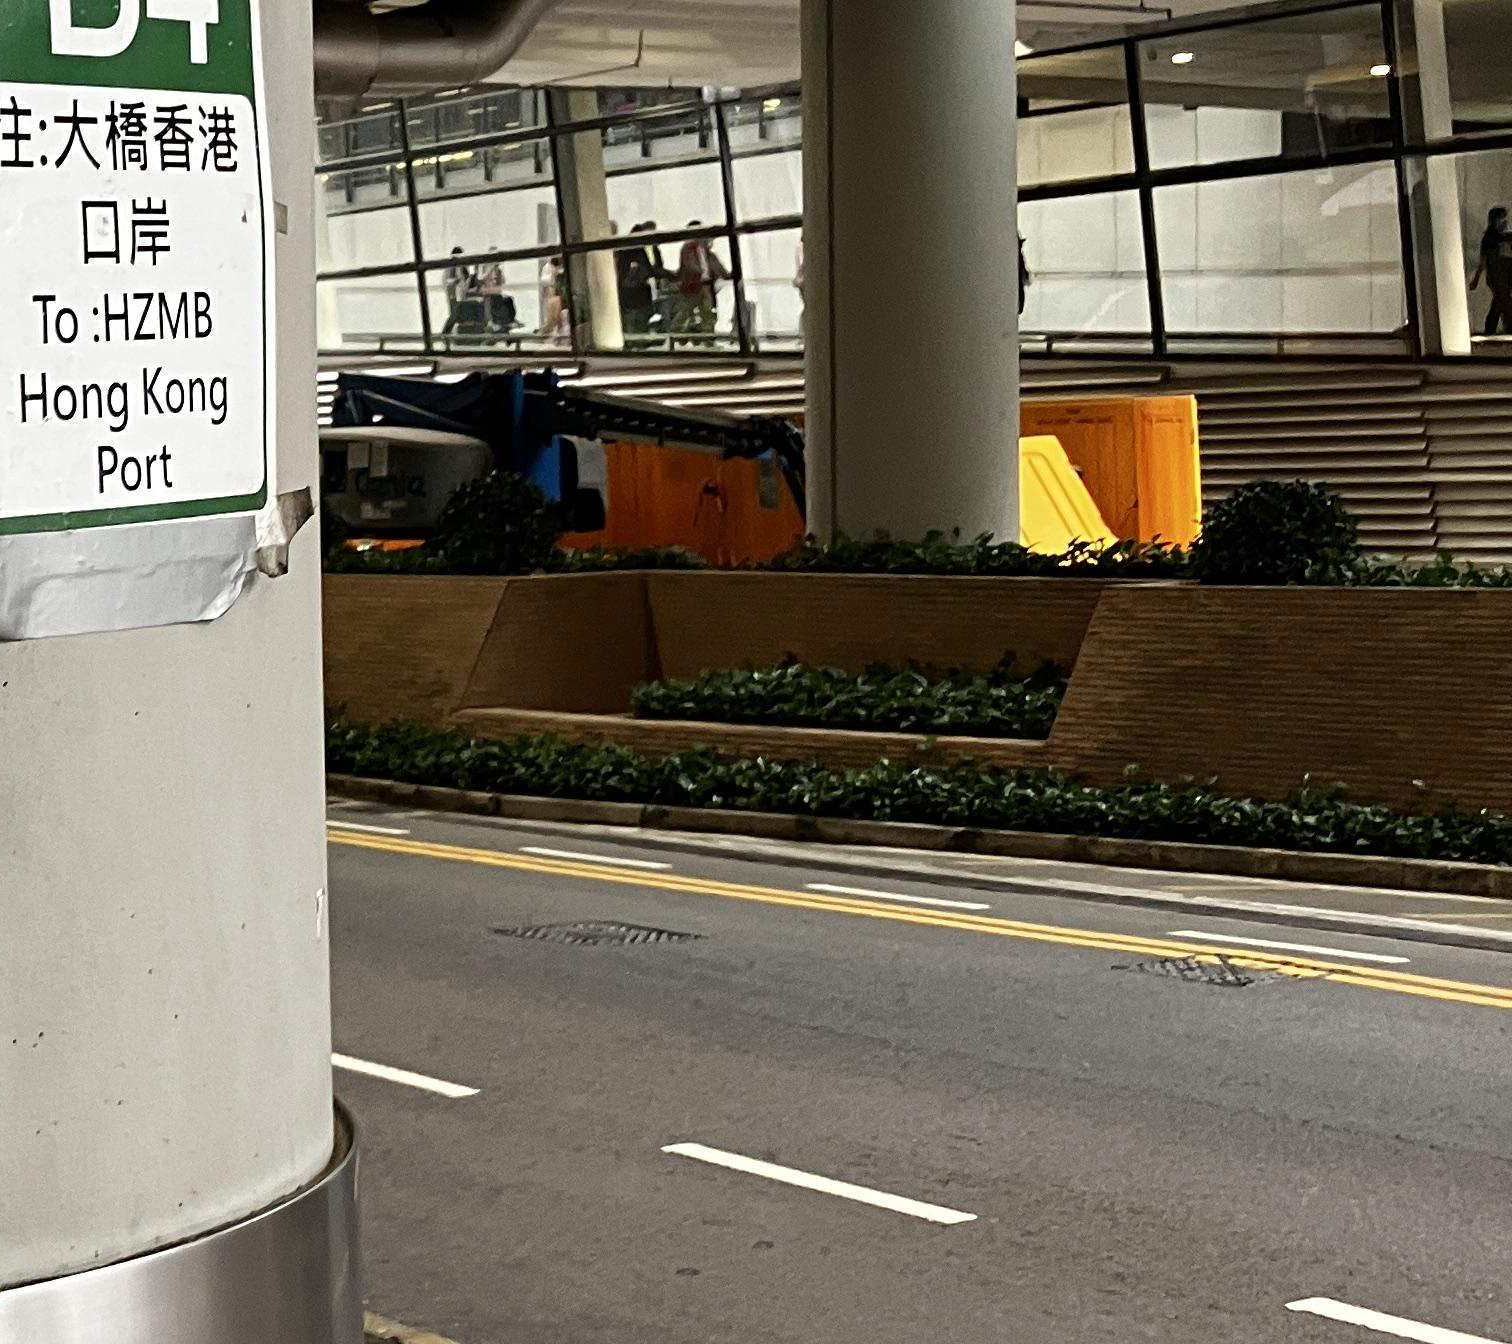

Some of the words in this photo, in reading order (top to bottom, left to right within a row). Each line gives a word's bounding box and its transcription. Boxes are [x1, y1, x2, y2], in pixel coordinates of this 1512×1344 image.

[81, 197, 170, 266] 口岸
[33, 294, 79, 343] To
[92, 292, 213, 341] :HZMB
[20, 372, 129, 431] Hong
[143, 367, 229, 424] Kong
[97, 445, 173, 494] Port
